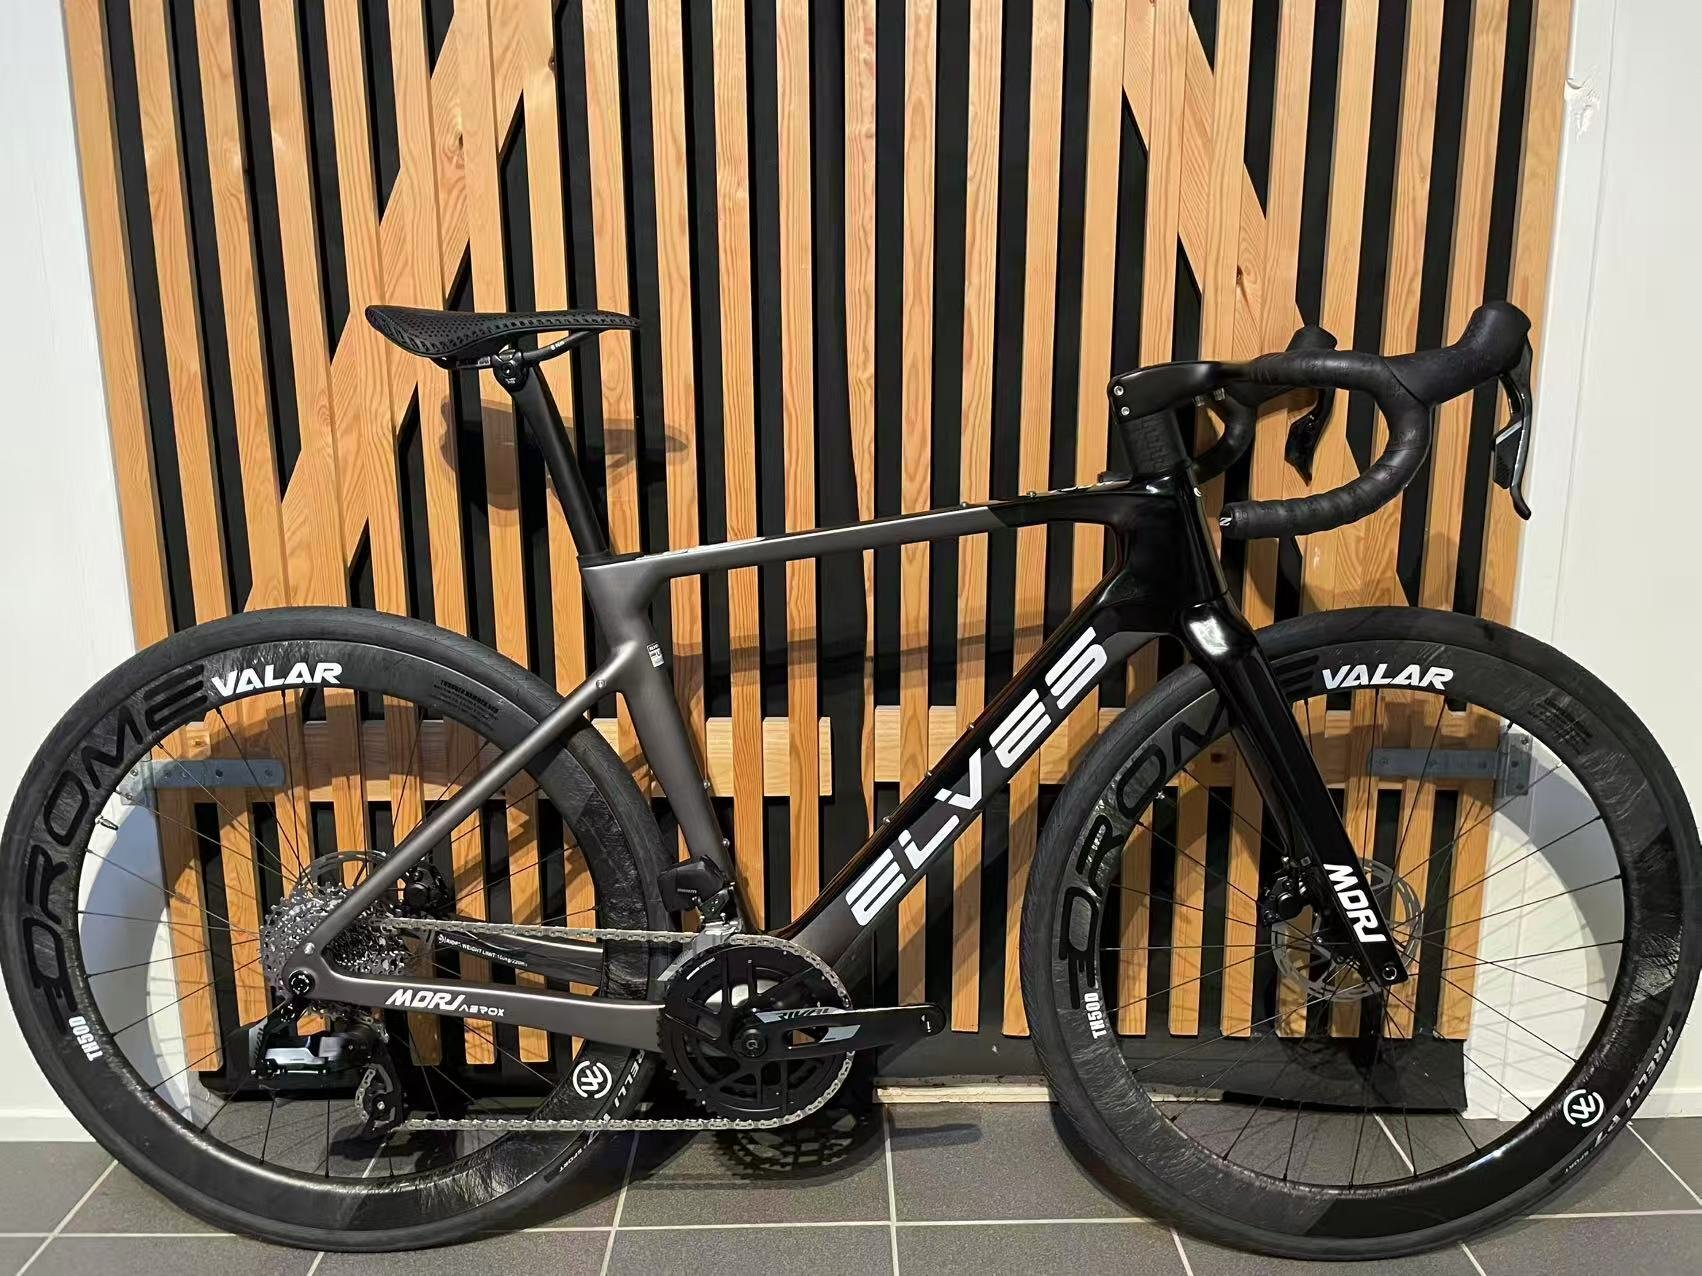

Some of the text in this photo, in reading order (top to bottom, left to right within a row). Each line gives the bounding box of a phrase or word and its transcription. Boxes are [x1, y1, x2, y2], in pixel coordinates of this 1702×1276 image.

[211, 661, 343, 697] VALAR
[1321, 663, 1454, 691] VALAR
[845, 626, 1108, 926] ELVES
[613, 1047, 648, 1109] RELLI
[1624, 1025, 1674, 1108] PIRELLI
